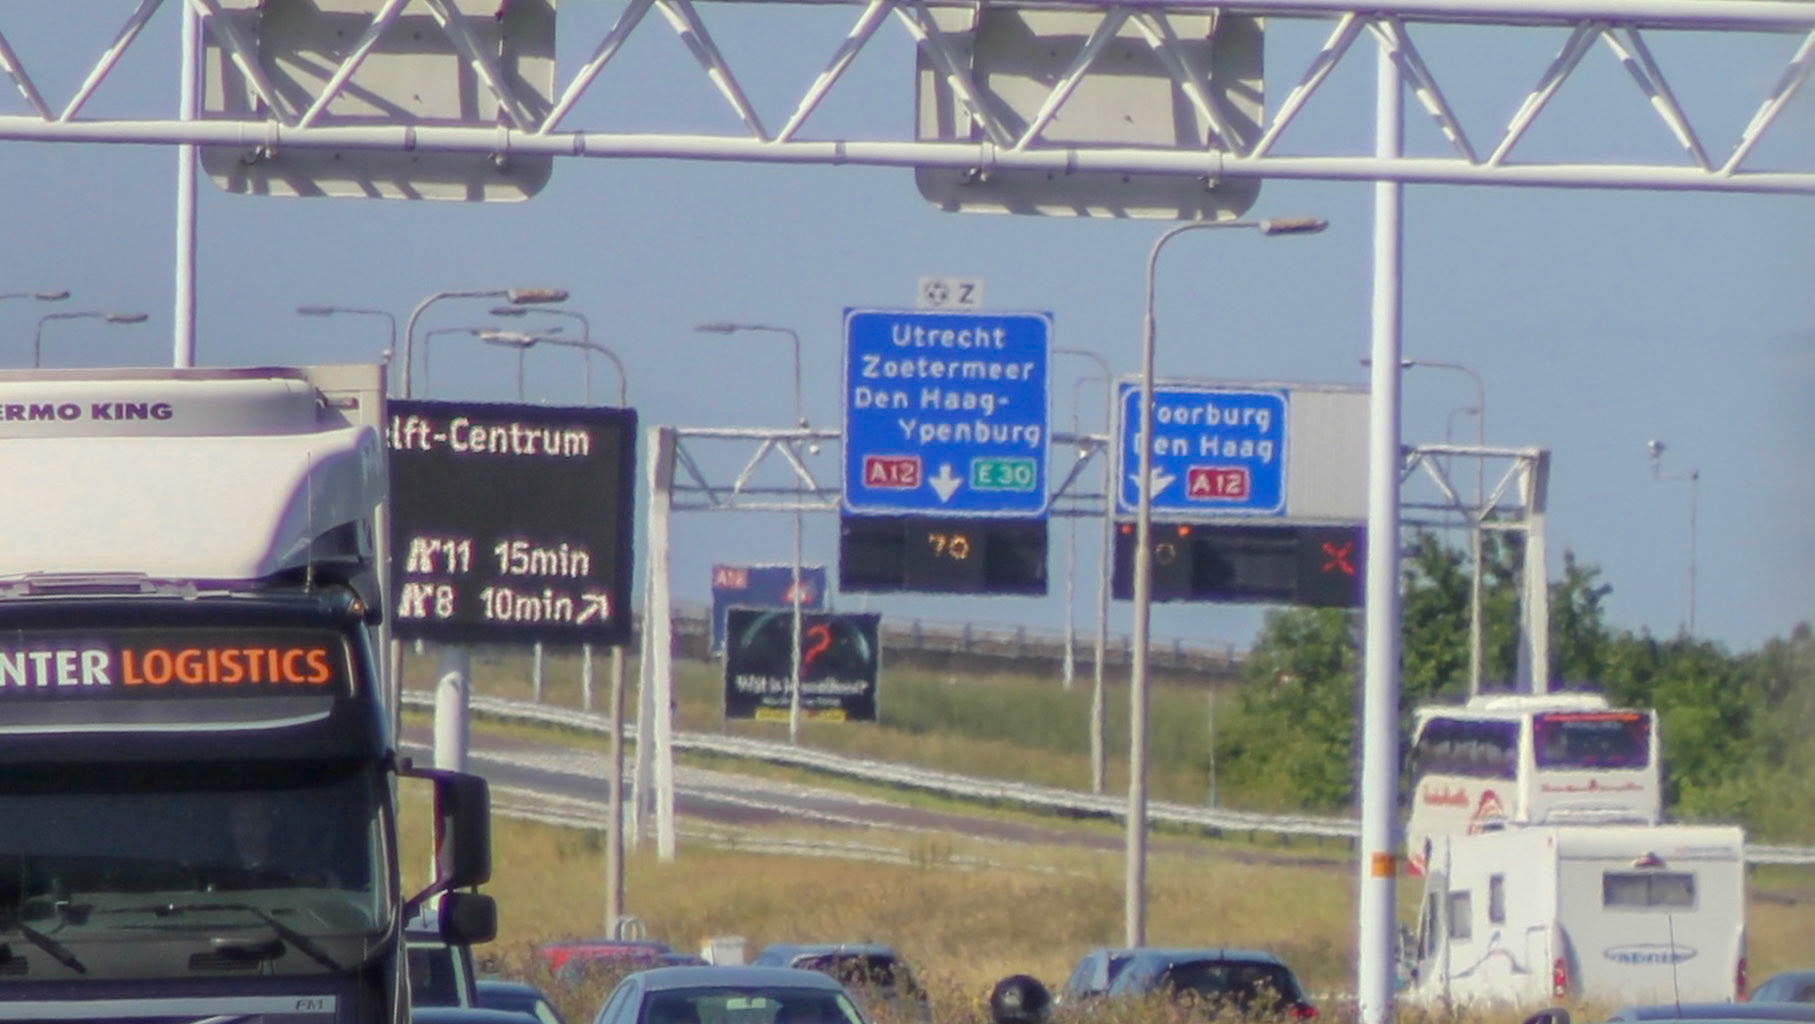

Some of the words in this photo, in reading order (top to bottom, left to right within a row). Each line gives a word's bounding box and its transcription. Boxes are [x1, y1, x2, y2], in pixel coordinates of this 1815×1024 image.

[959, 284, 975, 304] Z
[892, 324, 1006, 348] Utrecht
[862, 354, 1035, 380] Zoetermeer
[0, 403, 81, 421] RMO
[91, 402, 173, 421] KING
[854, 387, 909, 409] Den
[920, 387, 1010, 416] Haag-
[1150, 402, 1271, 433] oorburg
[386, 414, 590, 457] lft-Centrum
[898, 418, 1042, 449] Ypenburg
[1200, 435, 1273, 464] Haag
[869, 461, 915, 483] A12
[494, 540, 591, 578] 15min
[928, 533, 969, 560] 70
[435, 585, 455, 619] 8
[479, 587, 574, 622] 10min
[122, 649, 330, 686] LOGISTICS
[295, 999, 324, 1011] FM
